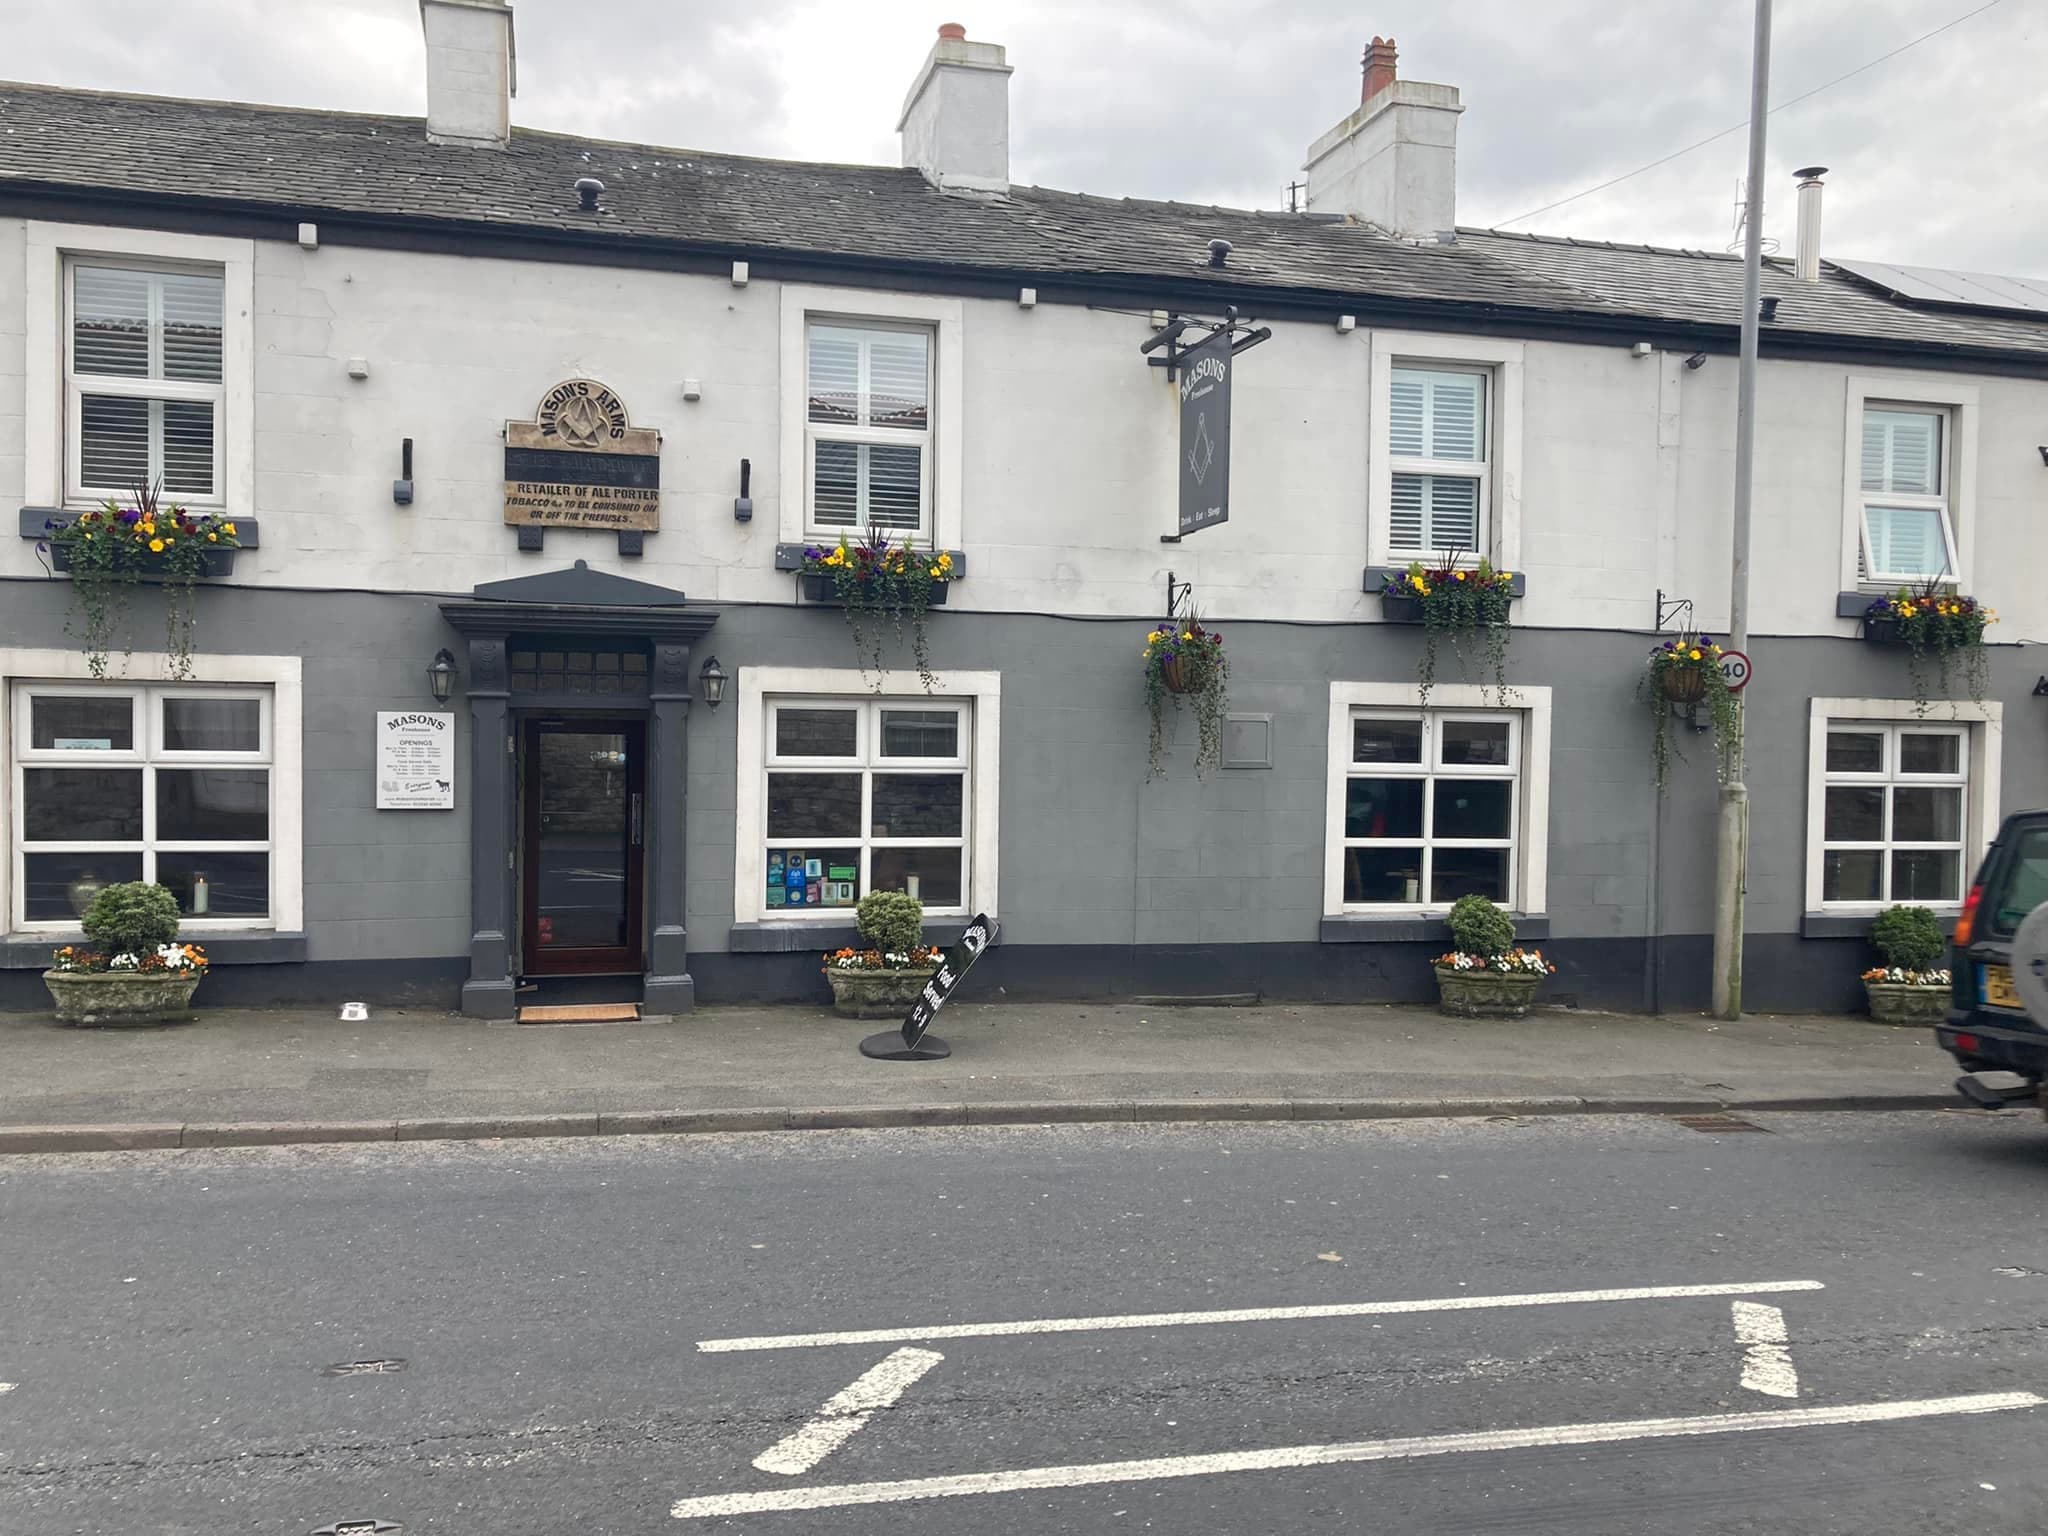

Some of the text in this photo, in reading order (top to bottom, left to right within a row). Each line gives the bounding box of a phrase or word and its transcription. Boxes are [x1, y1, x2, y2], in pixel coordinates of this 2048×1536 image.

[1181, 358, 1225, 402] MASONS
[541, 382, 625, 439] MASON'S ARMS
[518, 483, 658, 500] RETAILER OF ALE PORTER
[506, 497, 550, 508] TOBACCO
[564, 500, 575, 508] TO
[578, 501, 589, 509] BE
[592, 501, 640, 512] CONSUMED
[643, 504, 657, 513] ON
[530, 510, 543, 519] OR
[546, 511, 561, 520] OFF
[564, 512, 579, 520] THE
[1721, 663, 1745, 678] 40
[387, 714, 446, 731] MASONS
[937, 965, 957, 989] Food
[922, 980, 945, 1010] Served
